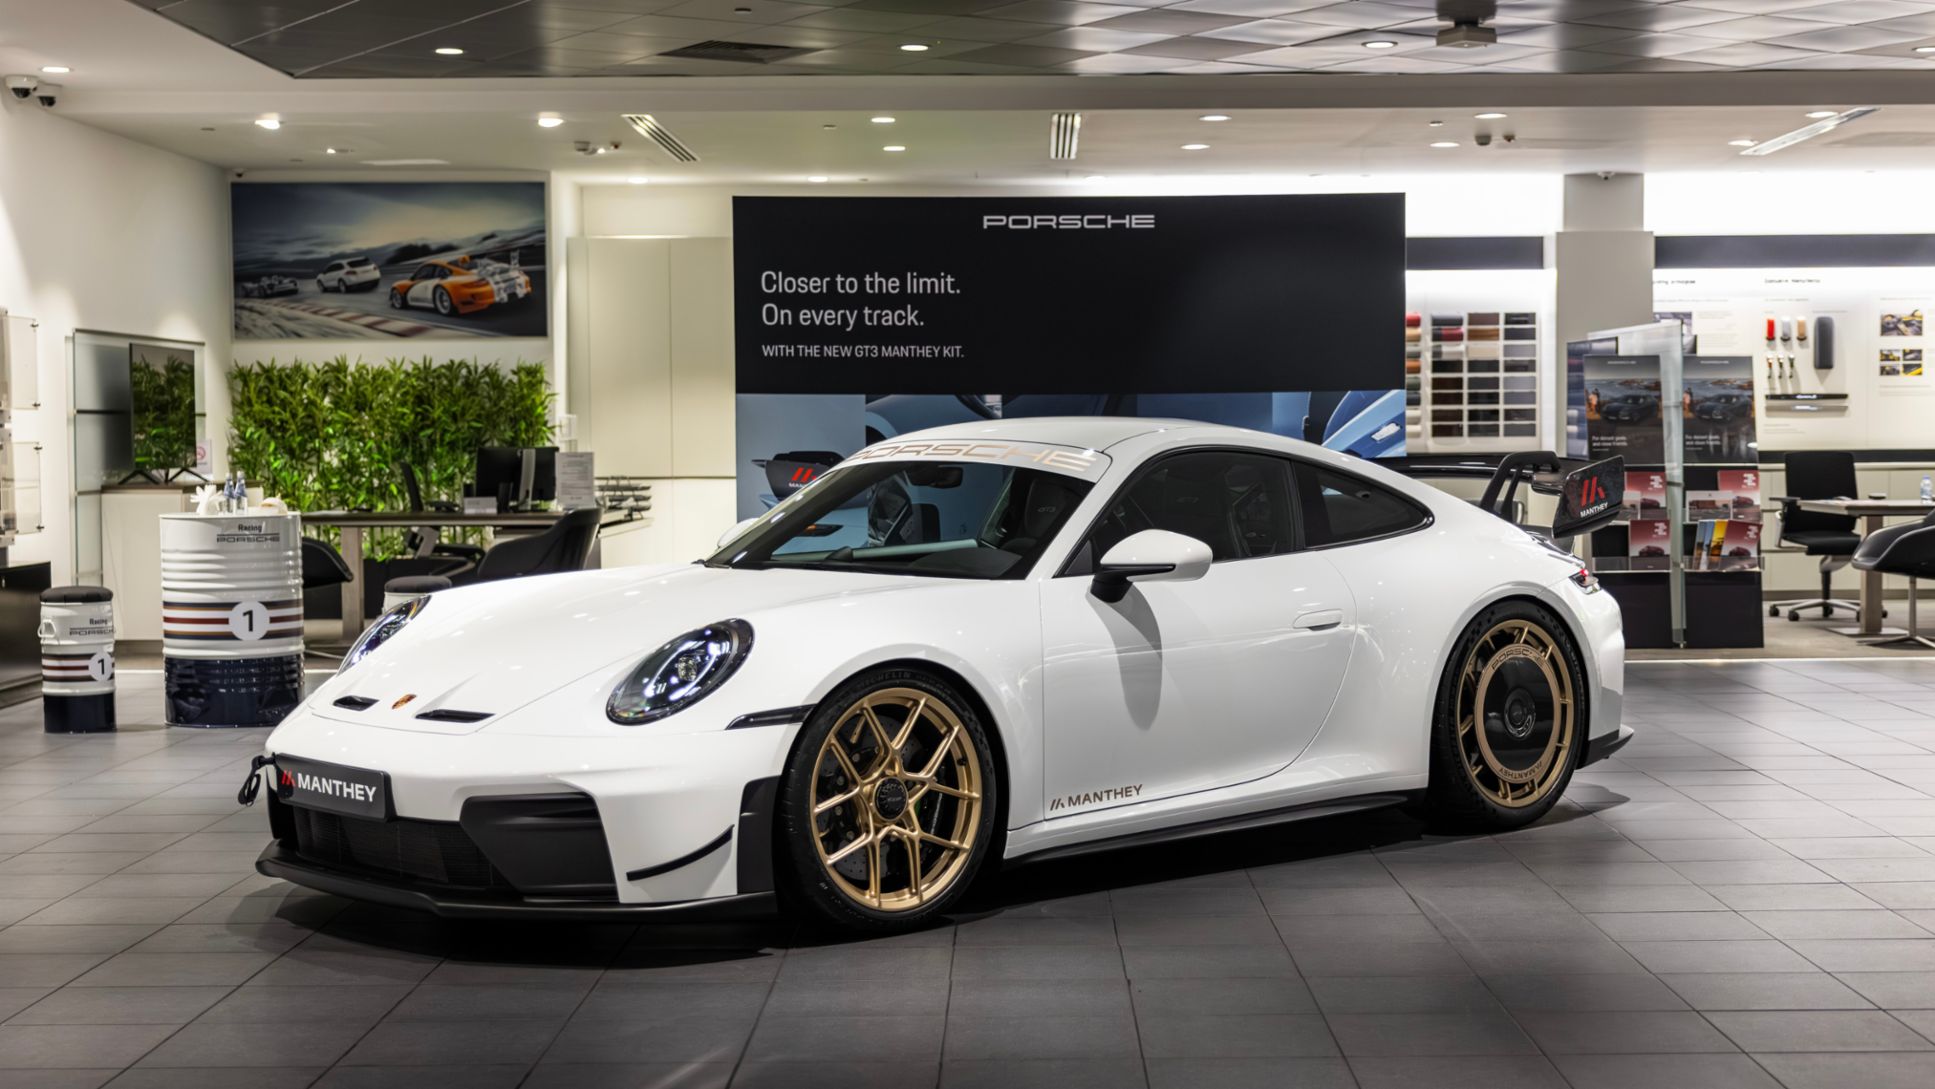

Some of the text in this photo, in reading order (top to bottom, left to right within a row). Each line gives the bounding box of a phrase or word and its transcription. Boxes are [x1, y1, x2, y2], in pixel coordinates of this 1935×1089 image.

[982, 214, 1156, 230] PORSCHE
[760, 270, 961, 294] Closer to the limit.
[761, 302, 924, 331] On every track.
[761, 345, 964, 358] WITH THE NEW GT3 MANTHEY KIT.
[852, 443, 1097, 472] PORSCHE
[1580, 502, 1609, 518] MANTHEY
[238, 524, 262, 533] Racing
[242, 610, 254, 632] 1
[97, 658, 105, 675] 1
[1491, 648, 1544, 669] PORSCE
[297, 772, 376, 803] MANTHEY
[1068, 784, 1143, 807] MANTHEY
